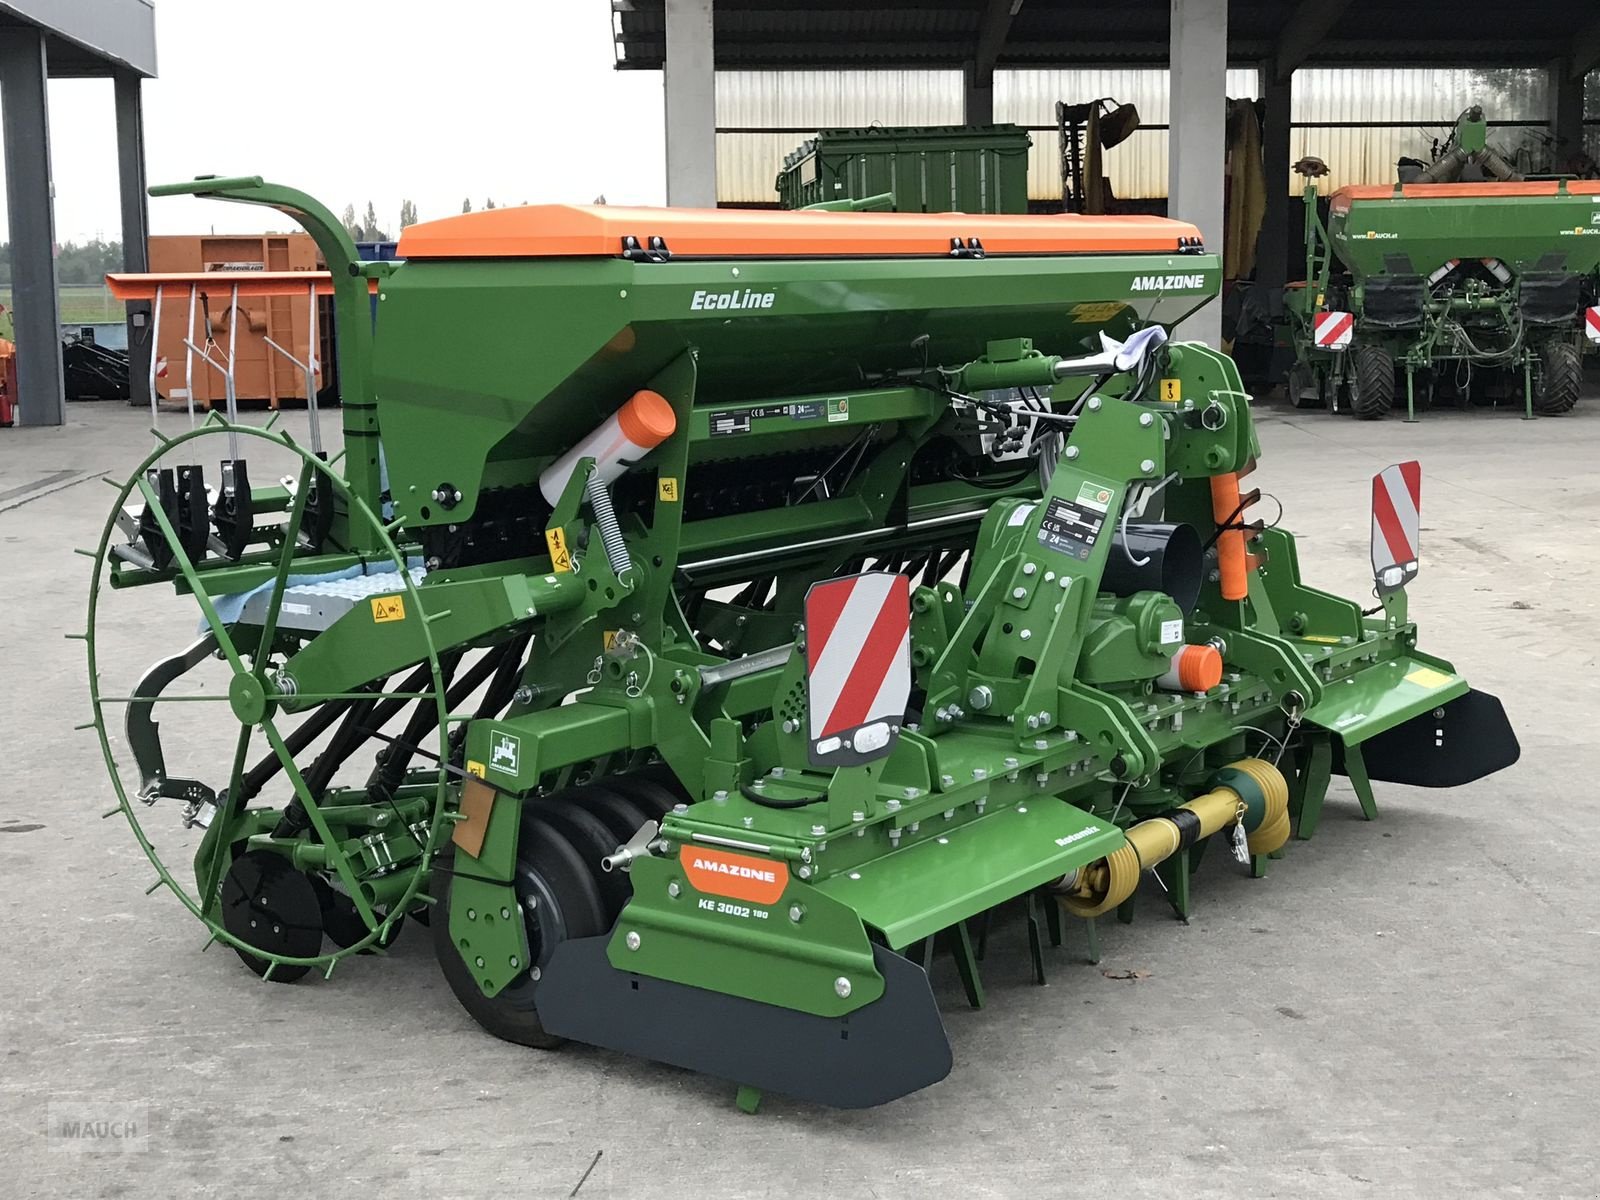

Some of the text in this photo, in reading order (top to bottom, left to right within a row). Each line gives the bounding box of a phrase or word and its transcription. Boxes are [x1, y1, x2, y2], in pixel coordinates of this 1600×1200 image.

[1130, 274, 1205, 291] AMAZONE
[690, 288, 775, 310] EcoLine
[1049, 533, 1060, 545] 24
[693, 858, 776, 884] AMAZONE
[698, 898, 716, 912] KE
[716, 901, 751, 919] 3002
